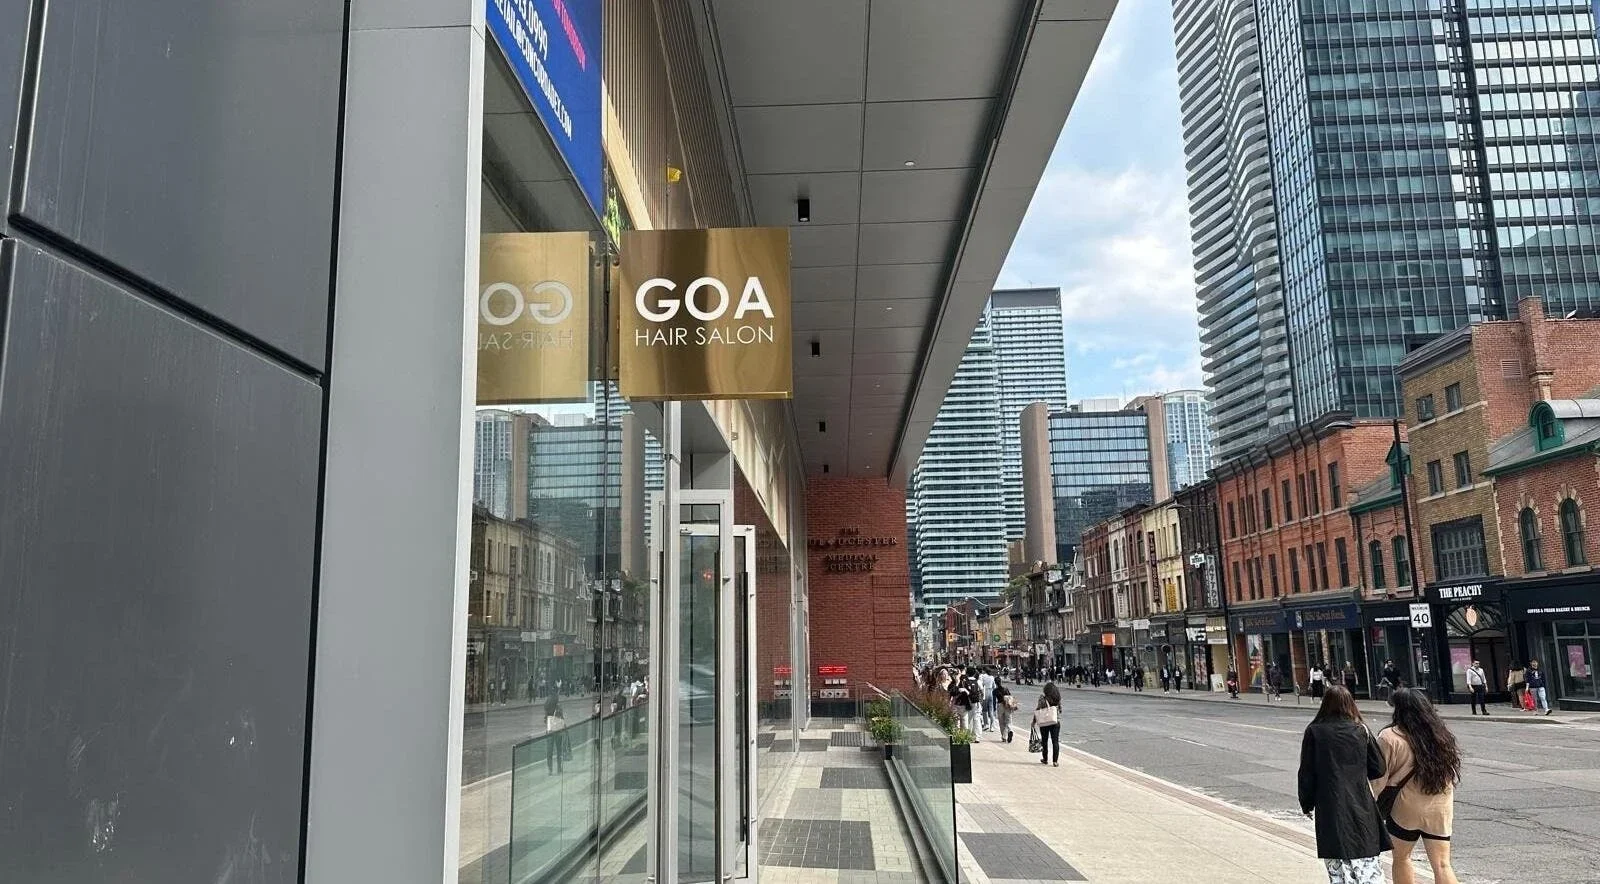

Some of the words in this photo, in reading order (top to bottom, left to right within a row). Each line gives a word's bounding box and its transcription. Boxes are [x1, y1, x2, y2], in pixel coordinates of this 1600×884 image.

[514, 0, 548, 61] 3.0999
[635, 276, 774, 322] GOA
[635, 328, 687, 347] HAIR
[695, 325, 774, 345] SALON
[826, 552, 880, 562] MEDICAL
[830, 563, 875, 571] CENTRE
[1438, 587, 1453, 599] THE
[1453, 584, 1482, 598] PEACHY
[1413, 613, 1429, 624] 40
